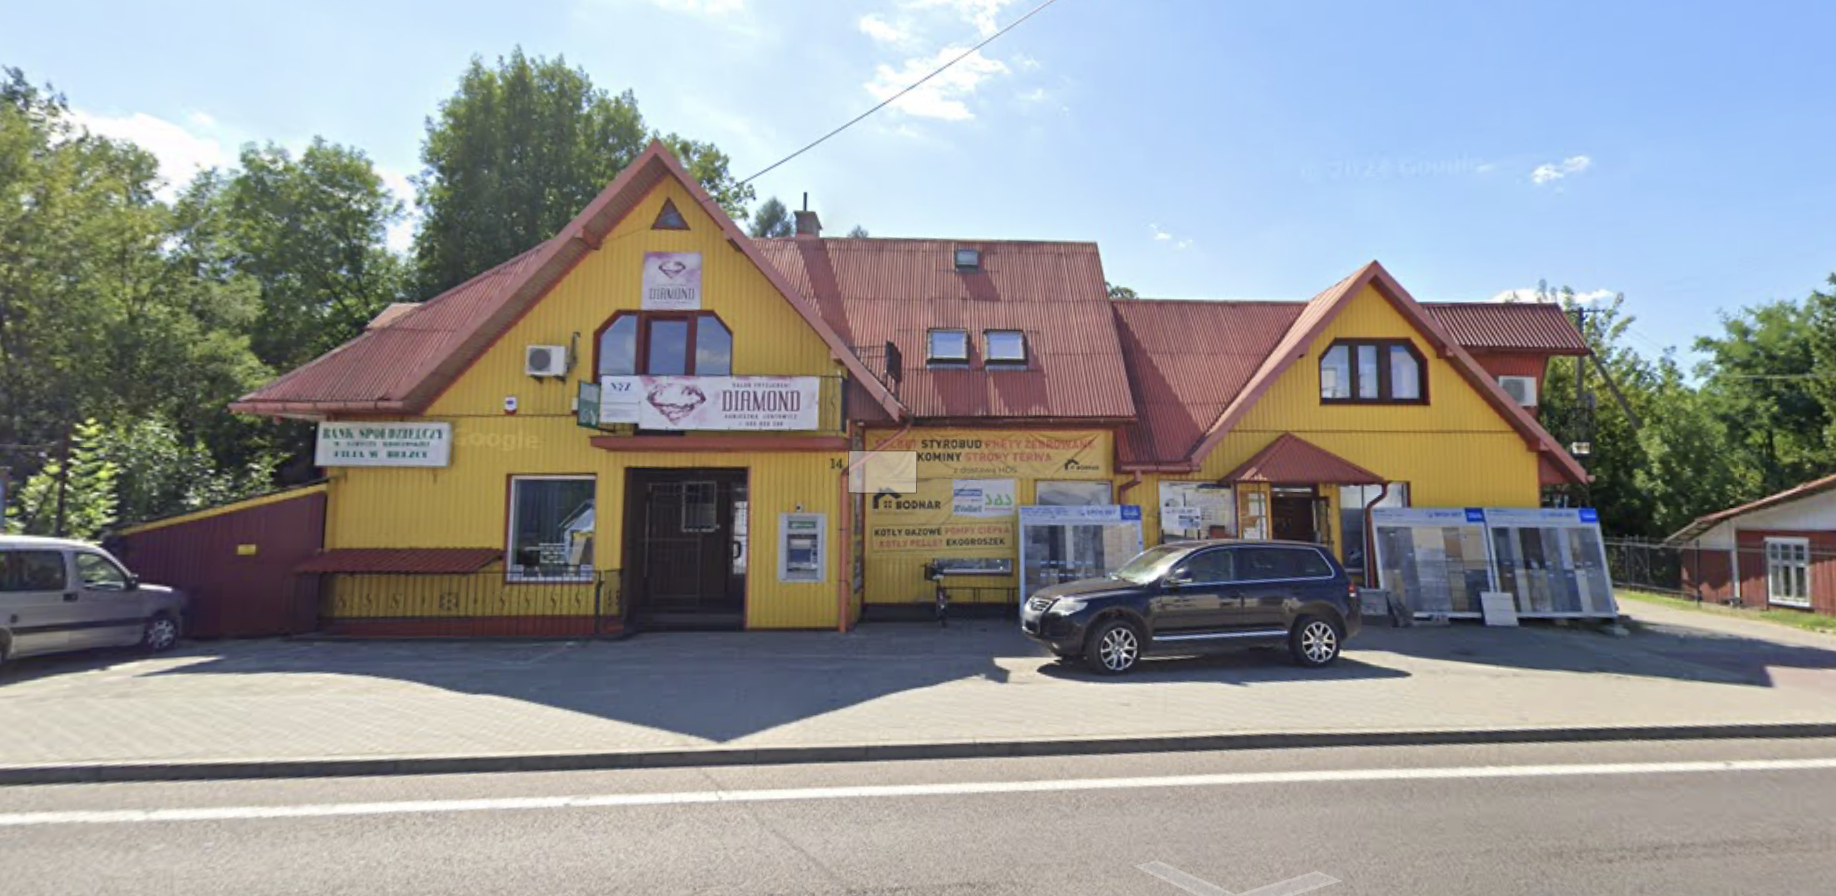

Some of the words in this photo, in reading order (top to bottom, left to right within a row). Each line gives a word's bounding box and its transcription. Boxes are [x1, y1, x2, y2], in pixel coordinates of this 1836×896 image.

[649, 287, 695, 300] DIAMOND
[722, 390, 801, 412] DIAMOND
[322, 427, 354, 439] BANK
[921, 439, 982, 449] STYROBUD
[916, 452, 962, 462] KOMINY
[830, 458, 843, 469] 14
[896, 500, 941, 510] BODNAR
[874, 529, 902, 537] KOTŁY
[905, 527, 942, 537] GAZOWE
[946, 537, 1006, 547] EKOGROSZEK
